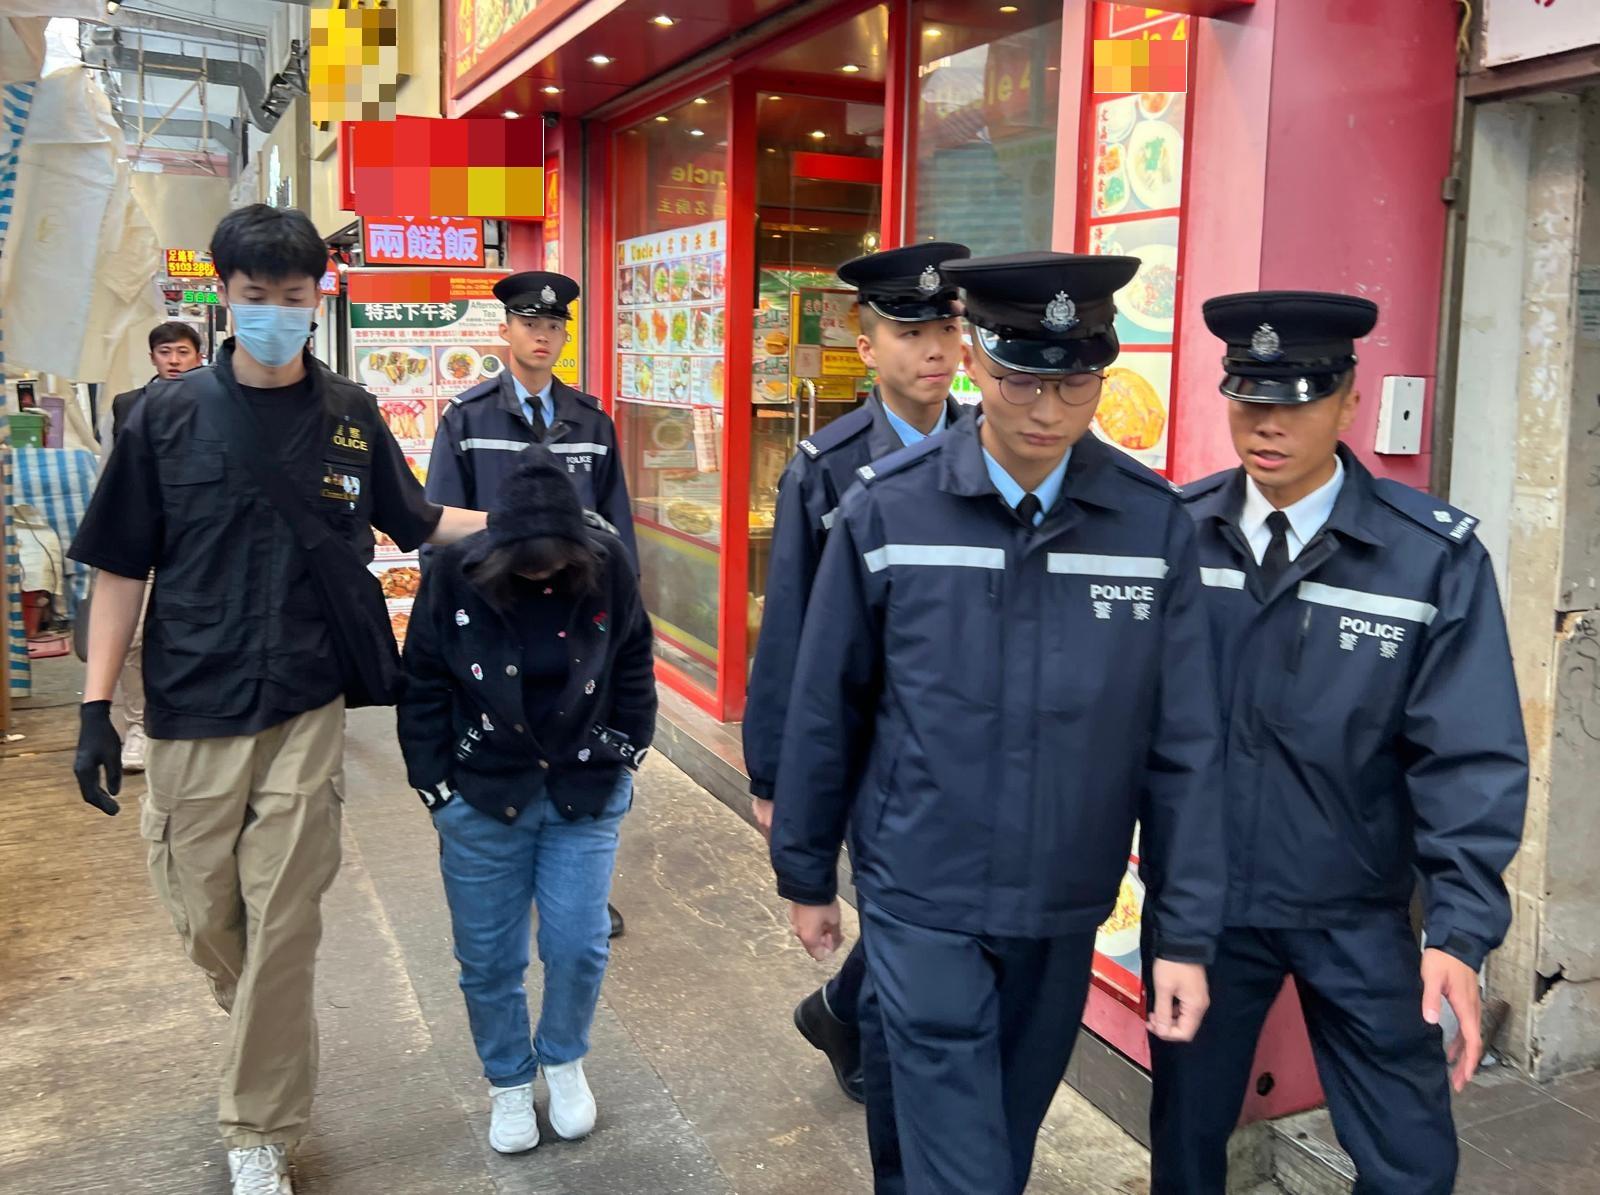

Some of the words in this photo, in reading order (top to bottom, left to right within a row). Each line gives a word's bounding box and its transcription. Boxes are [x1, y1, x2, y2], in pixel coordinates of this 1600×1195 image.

[368, 223, 479, 262] 兩餸飯
[364, 302, 457, 322] 特式下午茶
[471, 300, 506, 309] Afternoo
[333, 434, 369, 452] OLICE
[565, 455, 593, 464] POLICE
[1089, 583, 1155, 602] POLICE
[1338, 615, 1406, 643] POLICE
